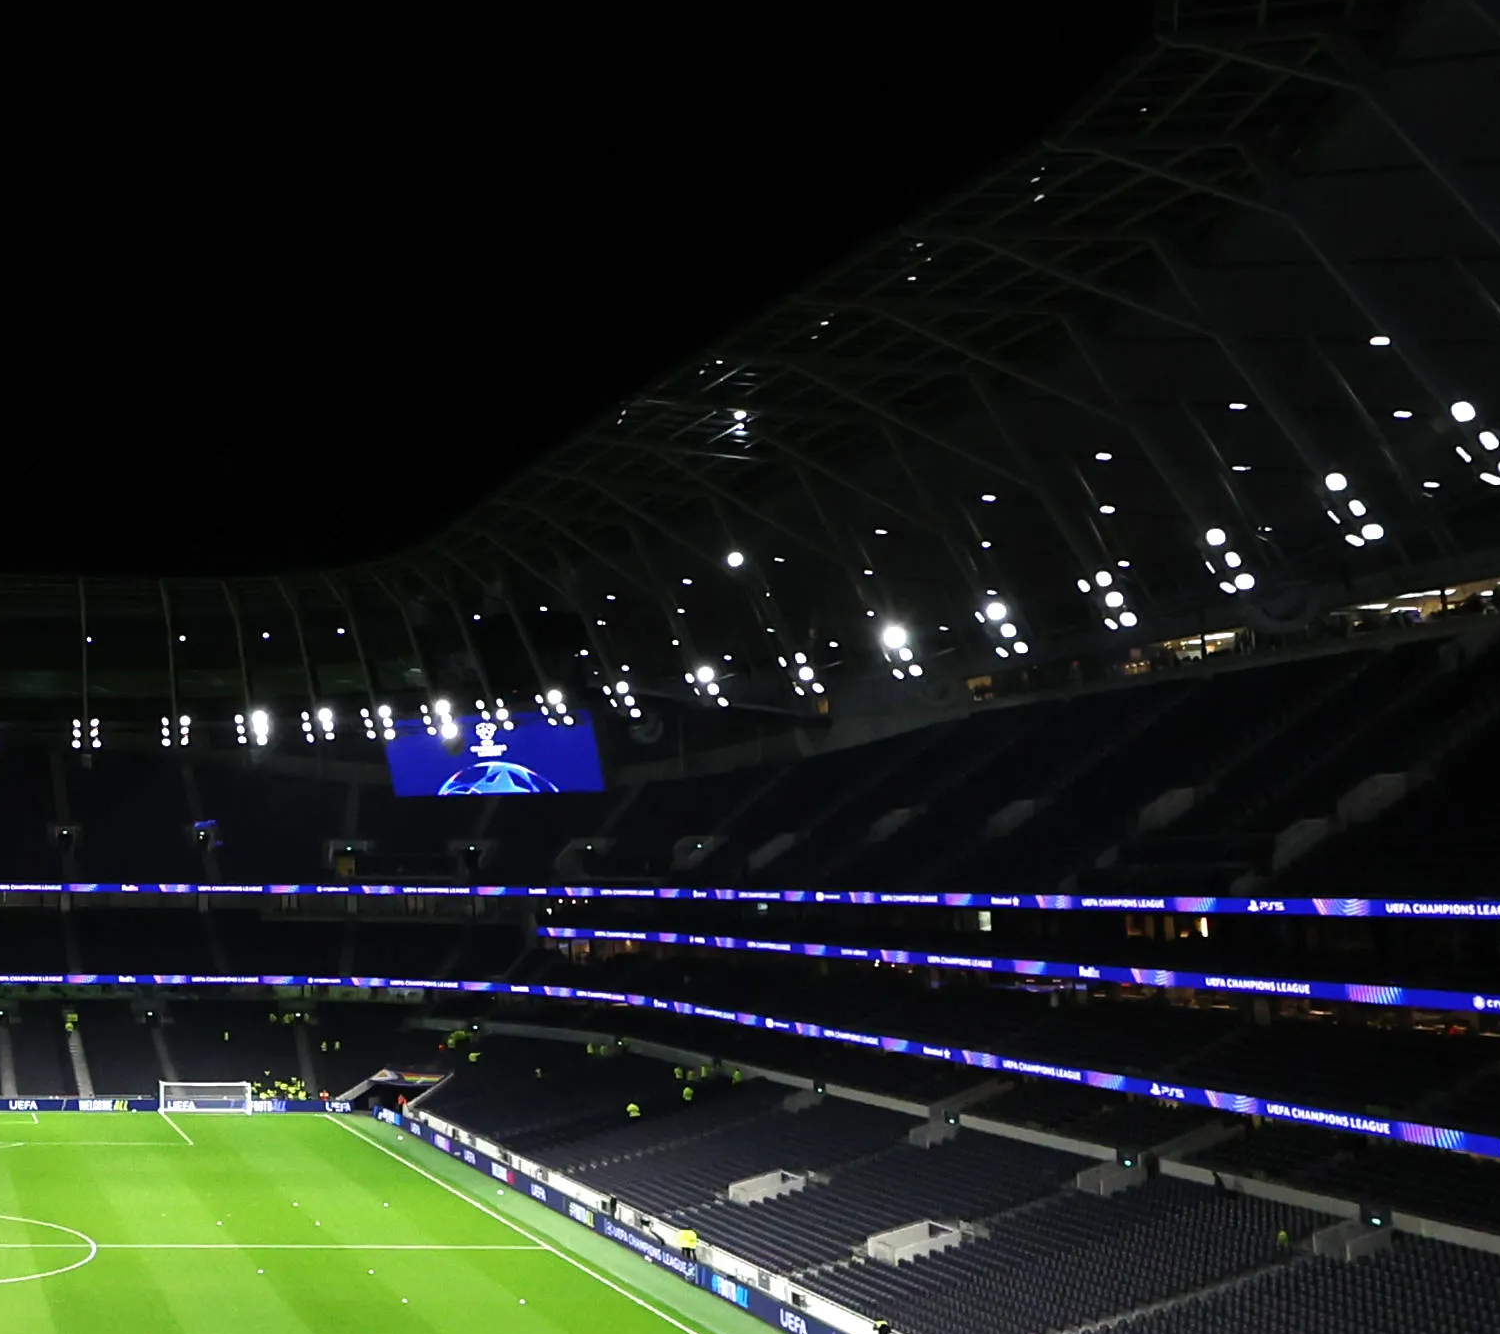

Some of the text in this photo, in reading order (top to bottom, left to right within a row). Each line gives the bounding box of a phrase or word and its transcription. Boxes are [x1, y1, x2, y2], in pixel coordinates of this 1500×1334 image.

[1260, 902, 1284, 910] PS5
[1386, 903, 1411, 913] UEFA
[1413, 904, 1478, 915] CHAMPIONS
[1206, 978, 1310, 994] UEFA CHAMPIONS LEAGUE
[1160, 1086, 1184, 1098] PS5
[9, 1099, 38, 1110] UEFA
[1267, 1104, 1390, 1134] UEFA CHAMPIONS LEAGUE
